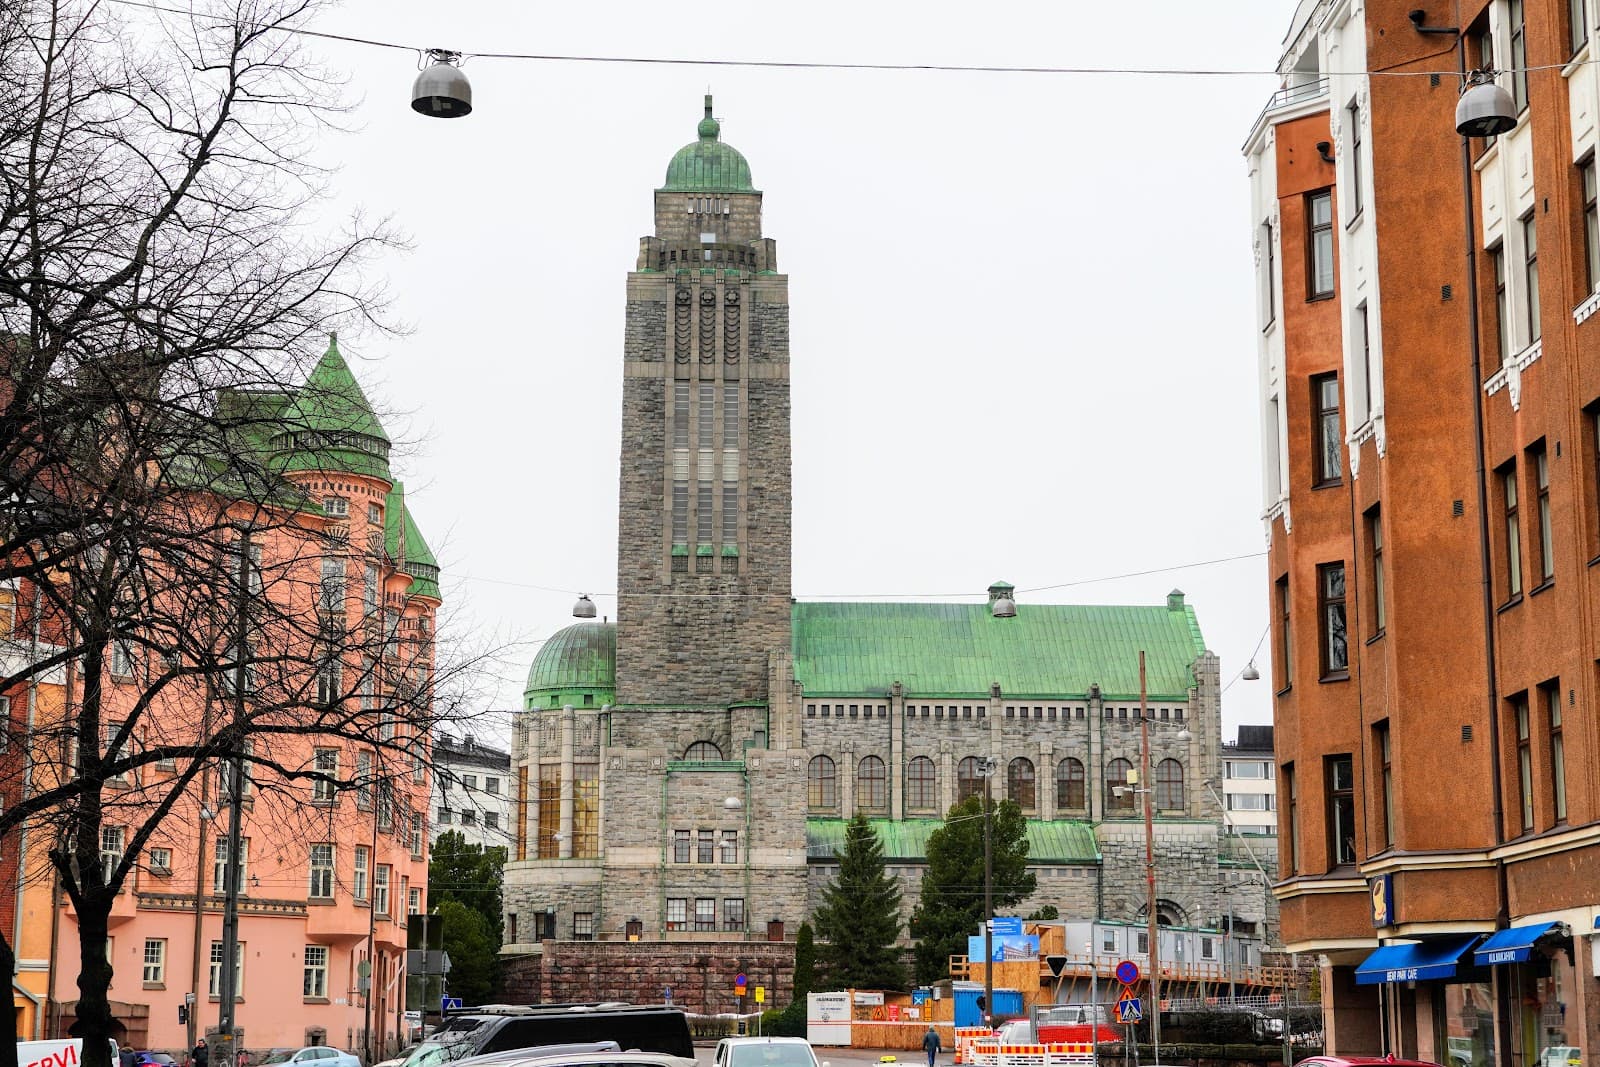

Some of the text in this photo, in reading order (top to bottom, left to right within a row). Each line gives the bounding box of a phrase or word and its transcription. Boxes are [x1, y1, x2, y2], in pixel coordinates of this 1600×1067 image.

[1387, 970, 1396, 981] BEAR
[1397, 969, 1407, 981] PARK
[27, 1045, 77, 1067] RVI
